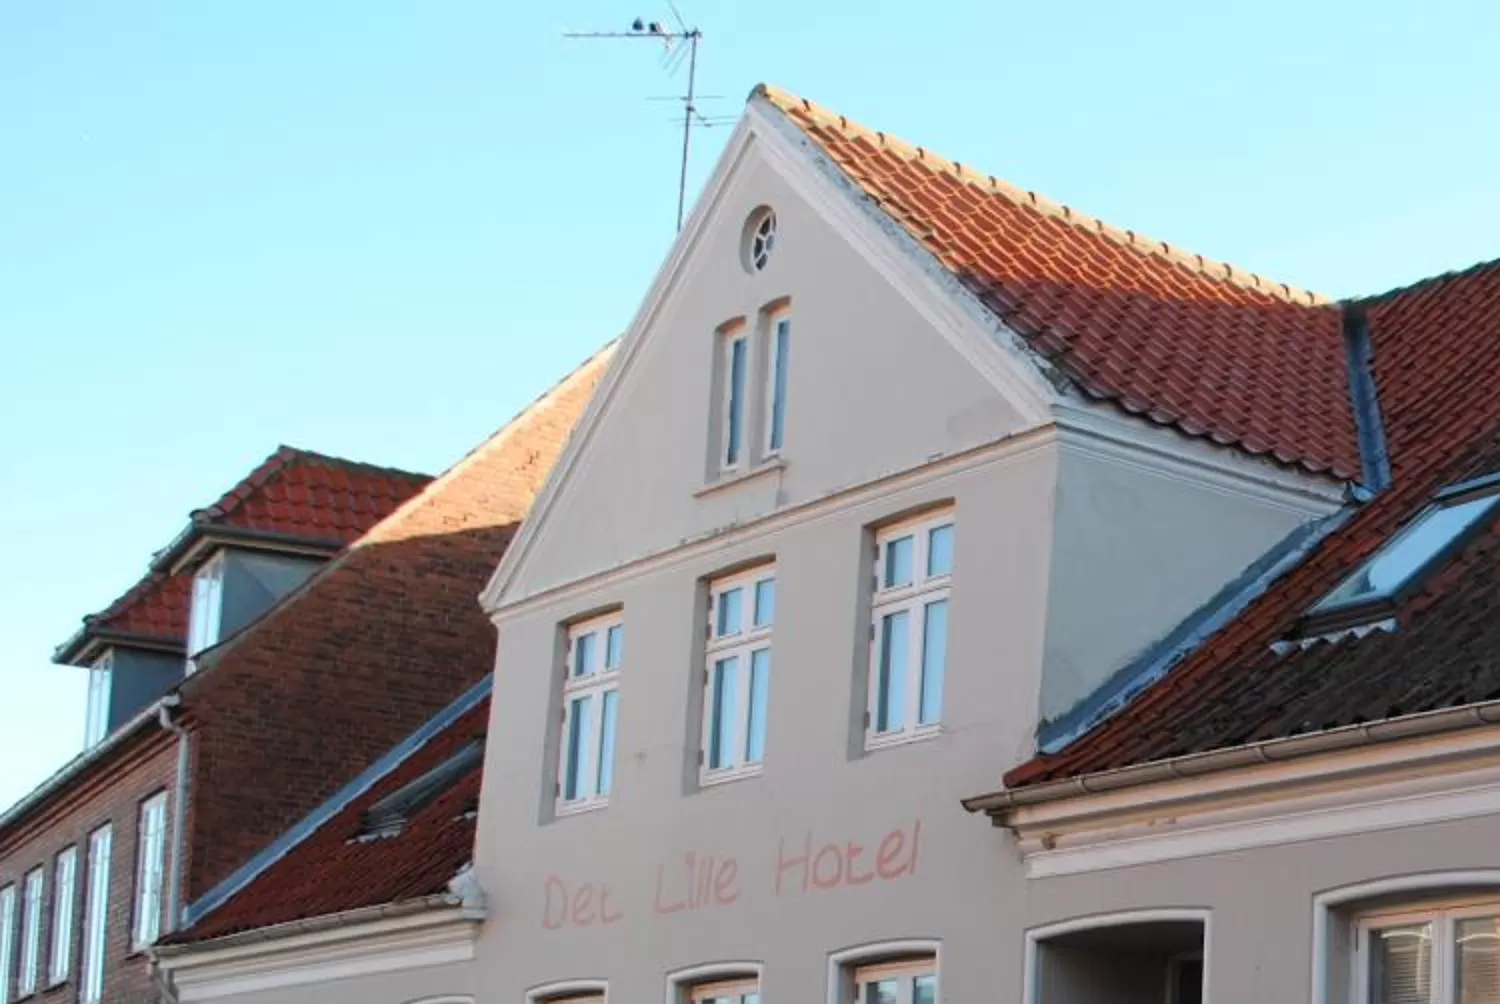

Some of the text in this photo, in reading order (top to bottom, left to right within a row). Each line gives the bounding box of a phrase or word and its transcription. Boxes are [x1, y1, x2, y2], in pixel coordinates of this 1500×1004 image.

[542, 818, 922, 931] Det Lille Hotel
